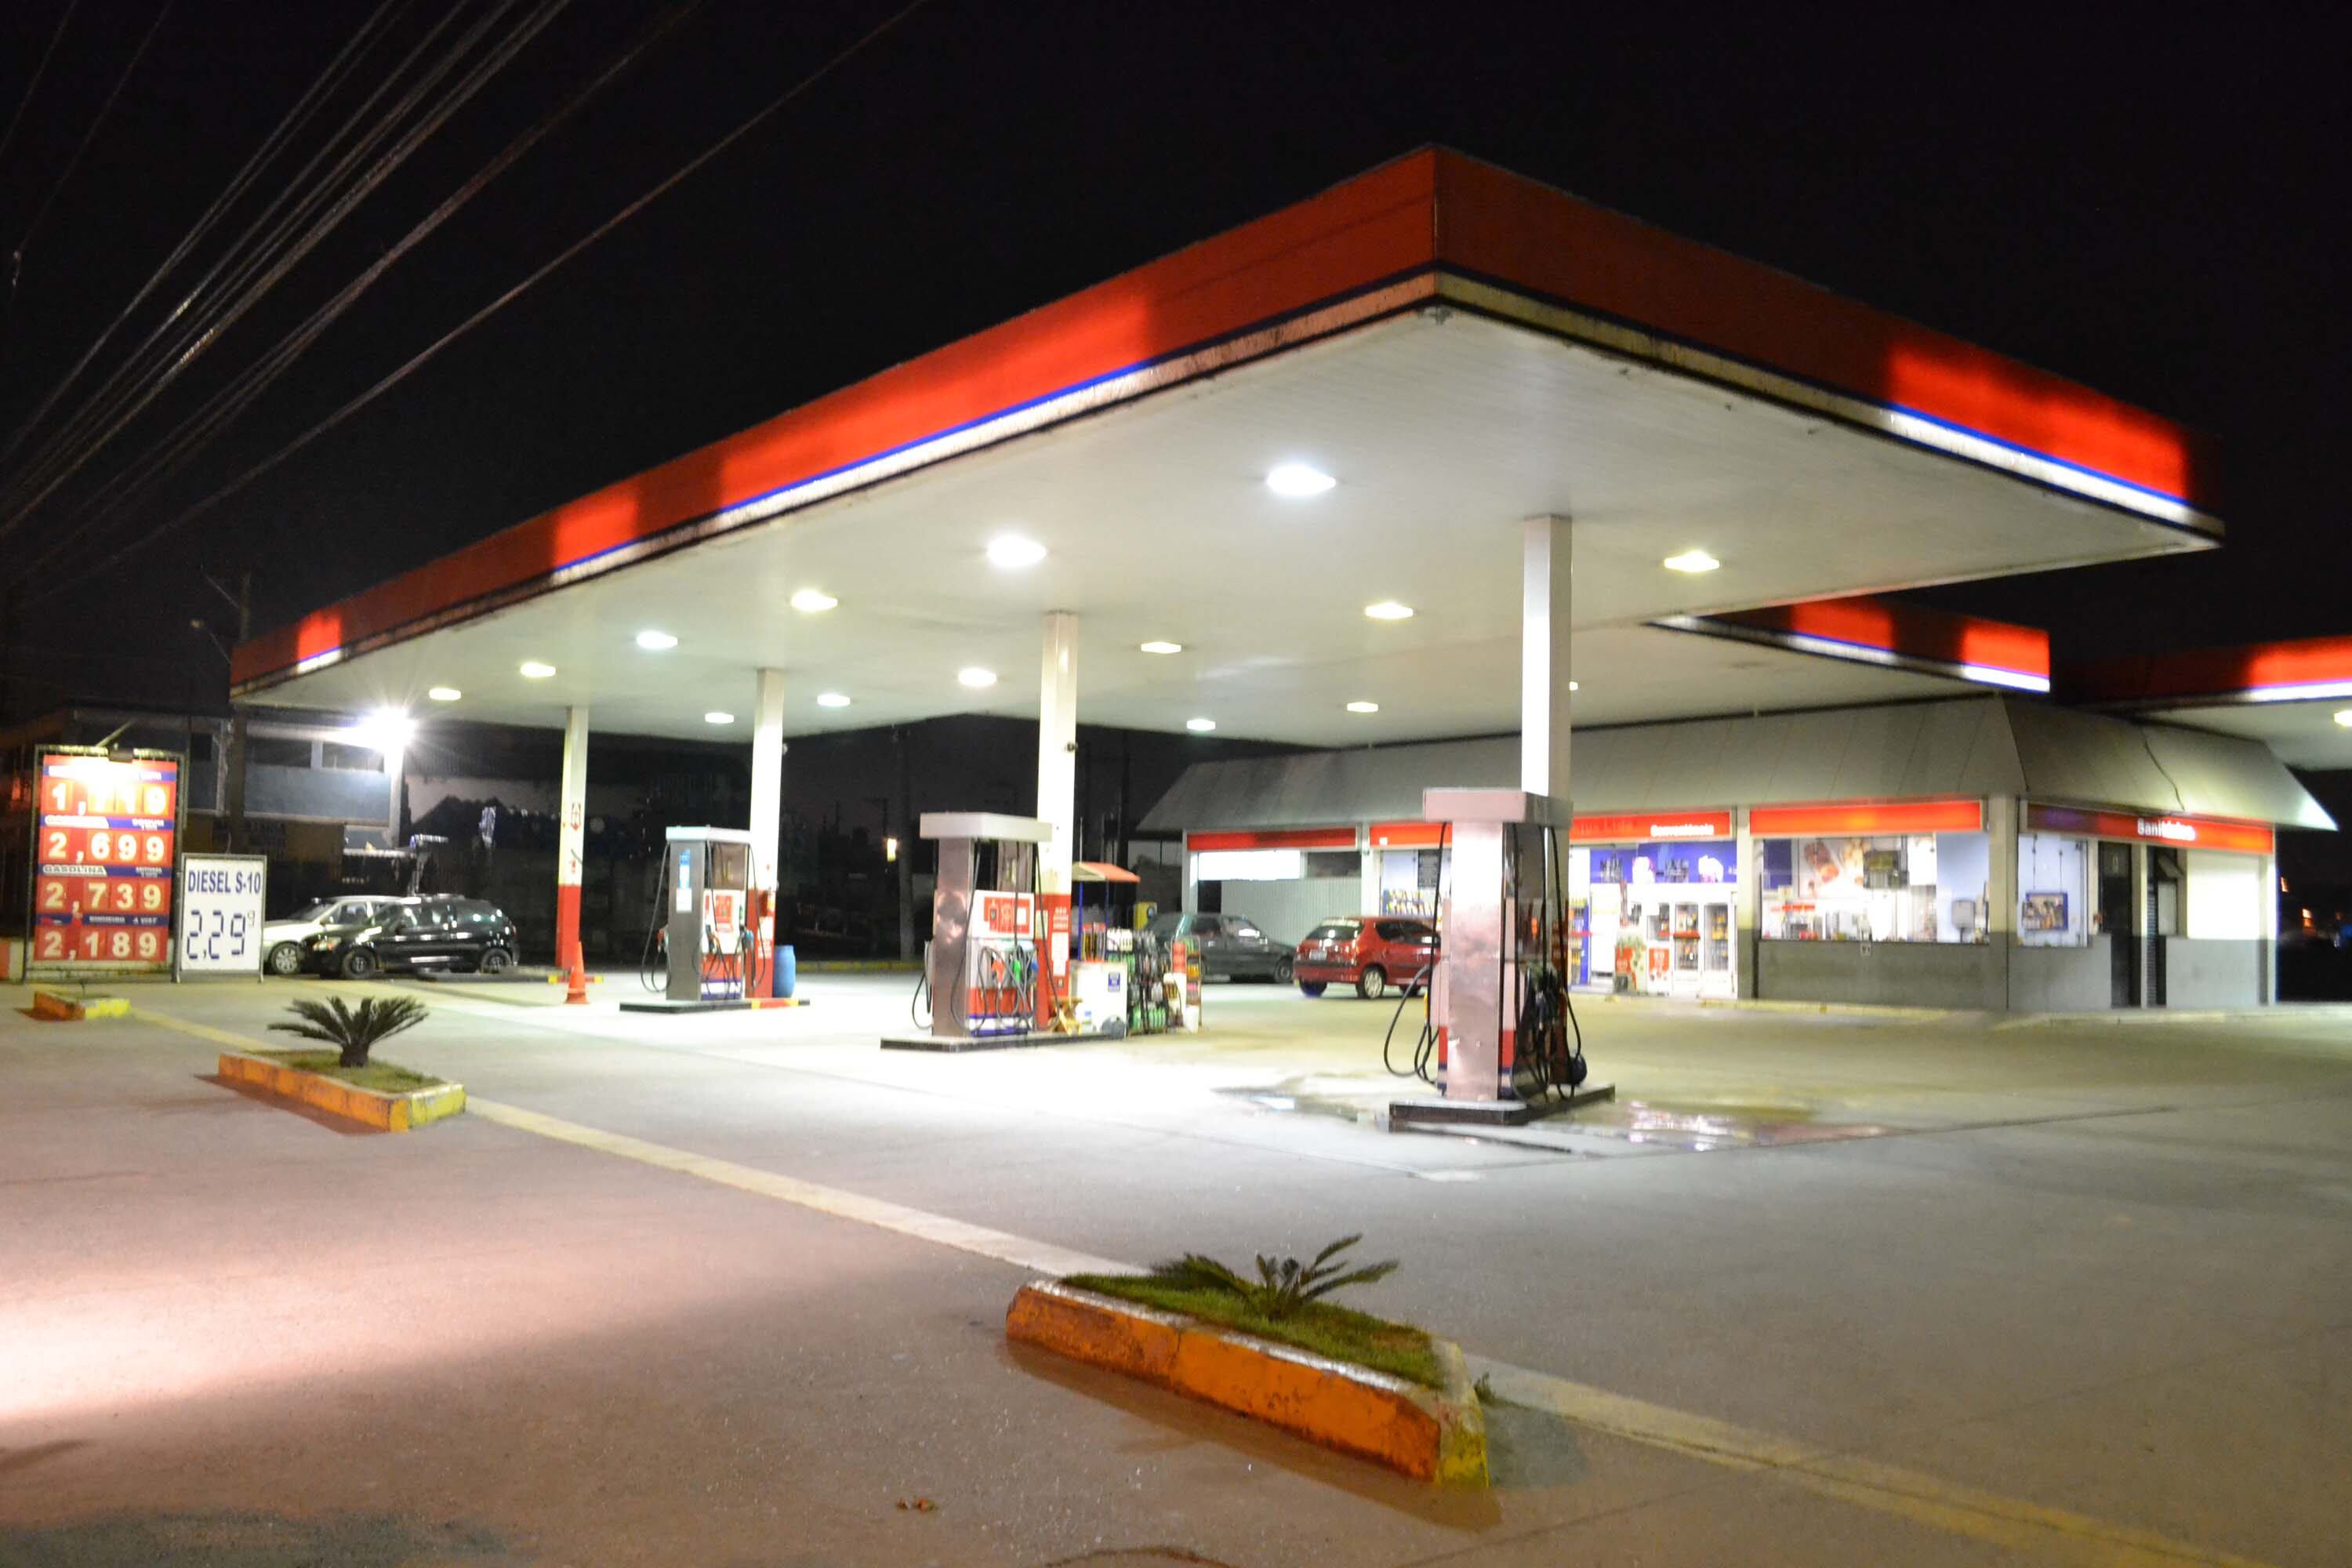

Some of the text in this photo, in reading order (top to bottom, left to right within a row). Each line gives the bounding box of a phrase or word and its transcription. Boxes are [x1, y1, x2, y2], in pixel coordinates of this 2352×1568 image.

[48, 832, 165, 866] 2,699
[43, 865, 104, 874] GASOLINA
[188, 870, 230, 892] DIESEL
[235, 871, 261, 893] S-10
[45, 881, 162, 913] 2,739
[43, 931, 158, 960] 2,189
